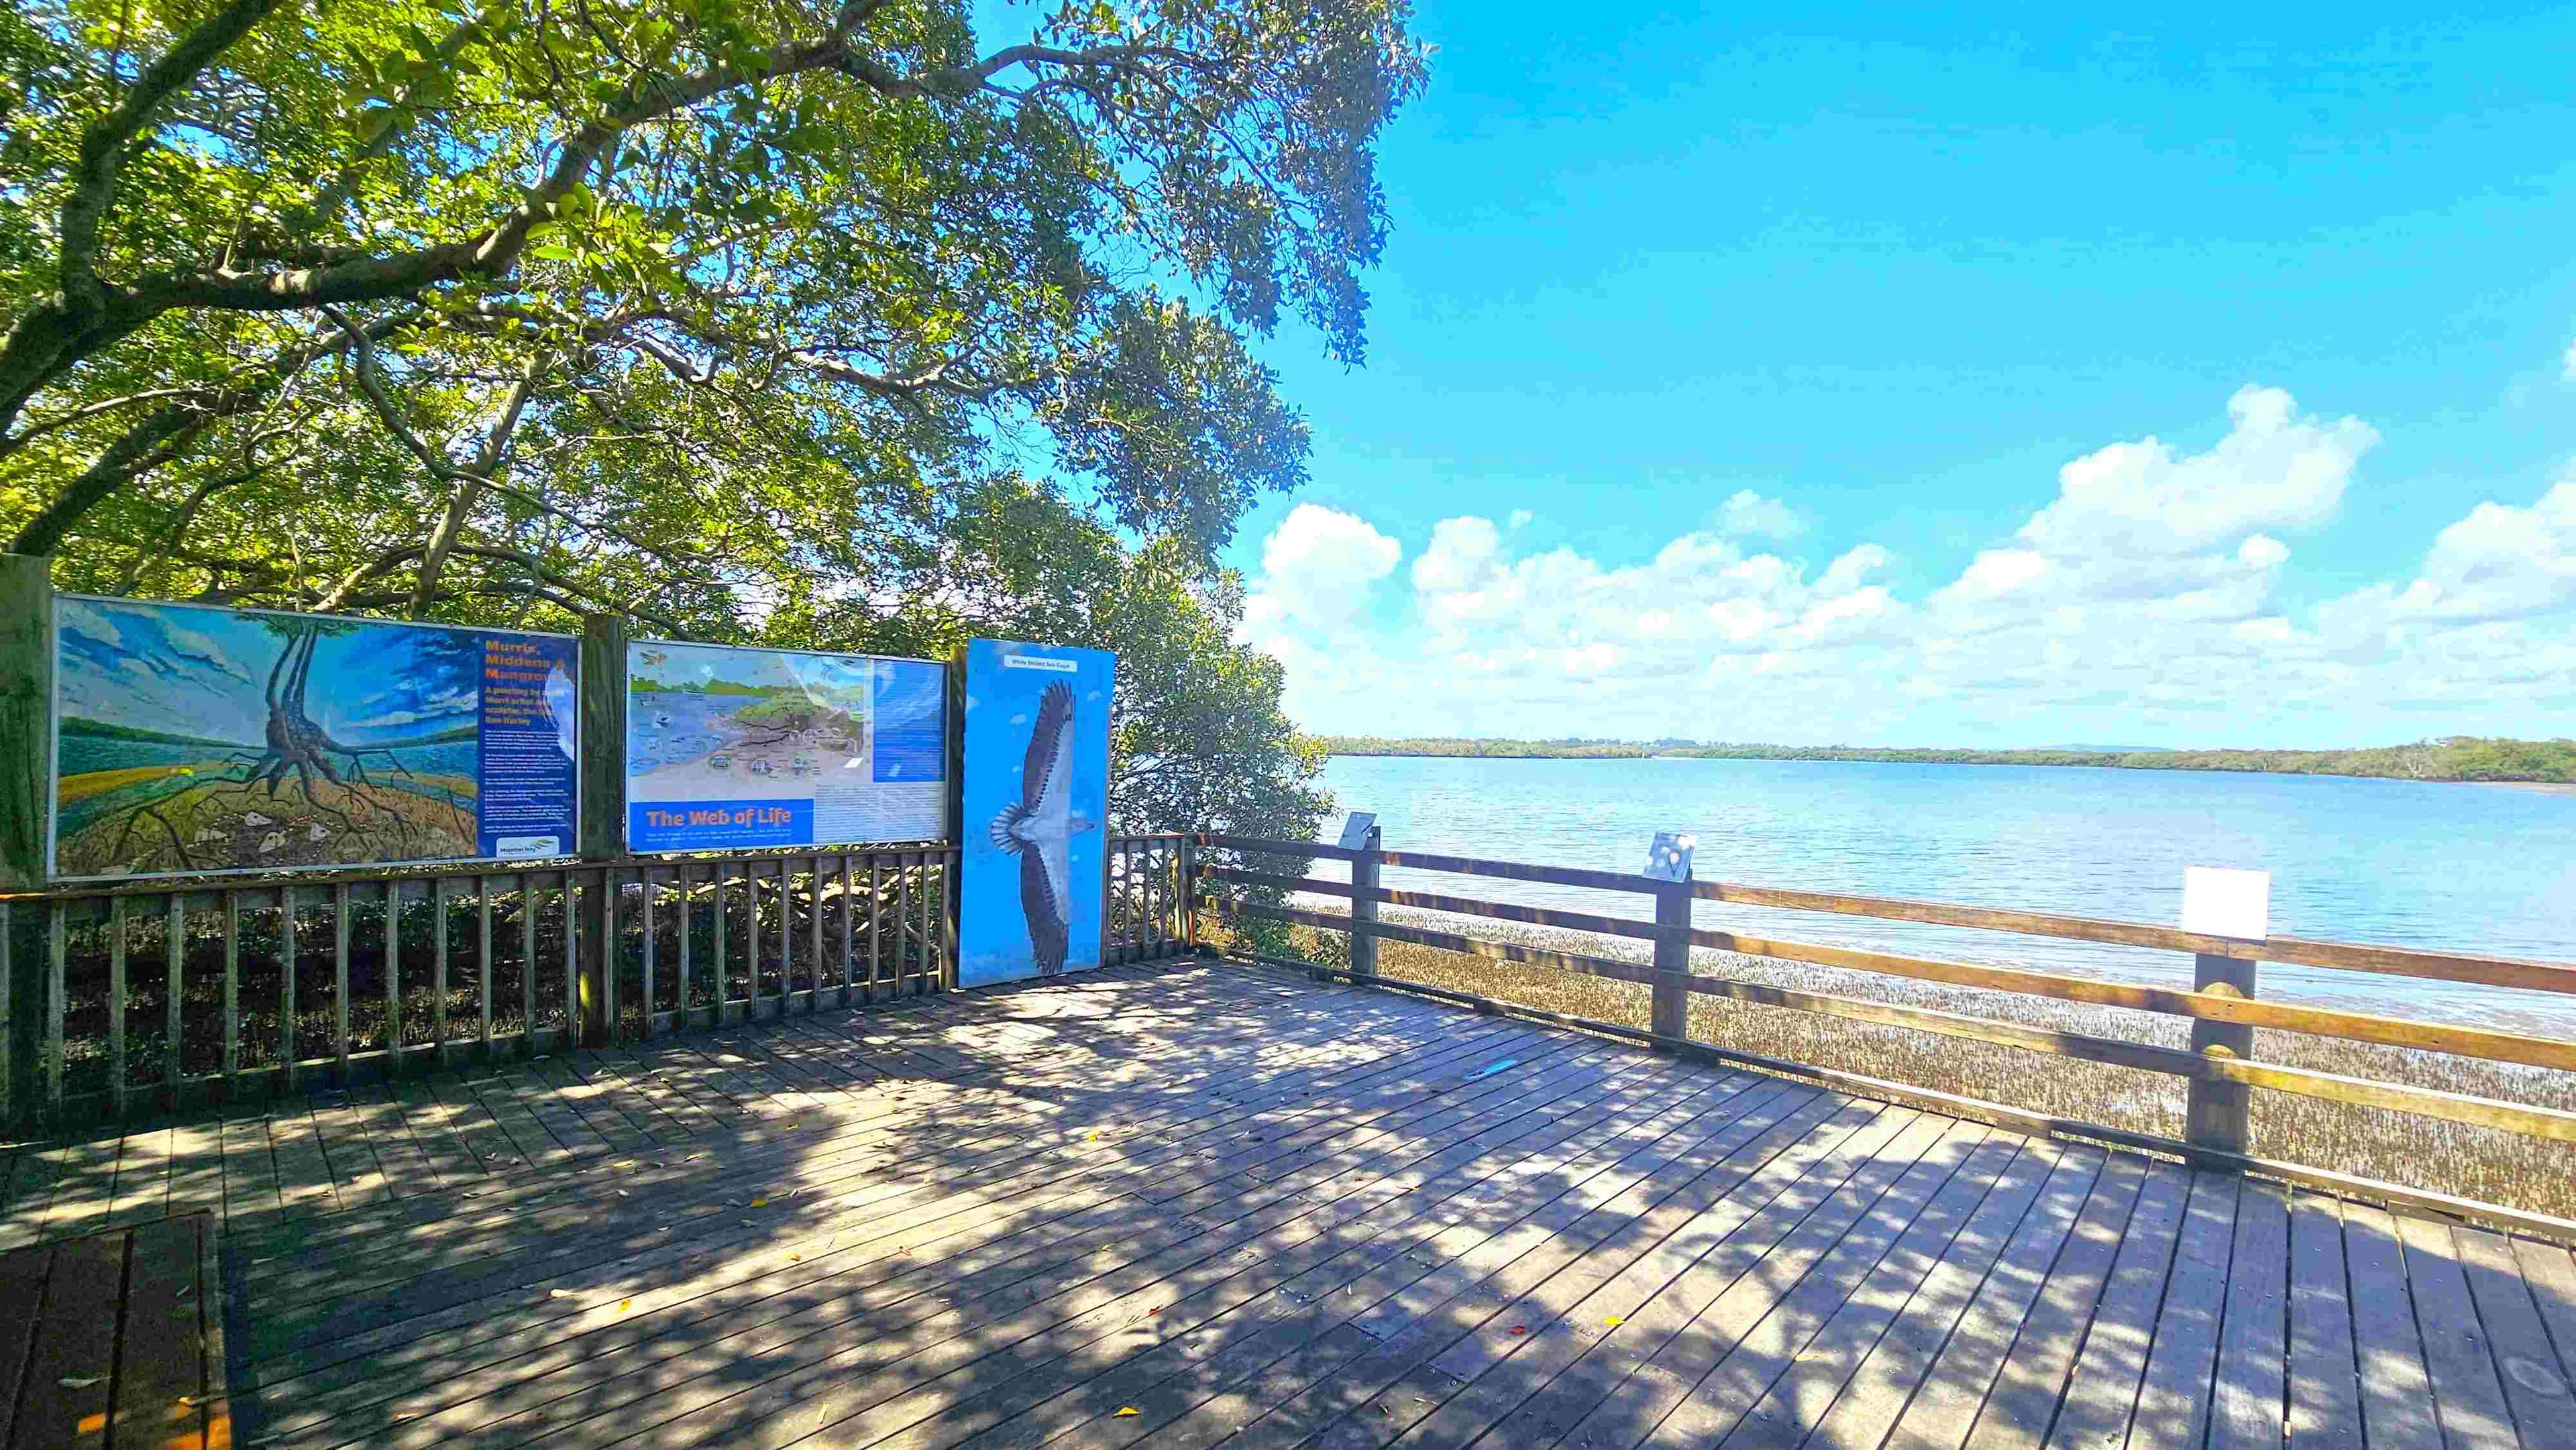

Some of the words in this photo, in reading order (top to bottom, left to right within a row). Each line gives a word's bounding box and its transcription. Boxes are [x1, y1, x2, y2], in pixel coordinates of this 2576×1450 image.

[486, 640, 539, 655] Murris,
[485, 654, 550, 669] Middens
[647, 809, 684, 826] The
[688, 809, 729, 826] Web
[734, 807, 755, 828] of
[758, 807, 792, 827] Life
